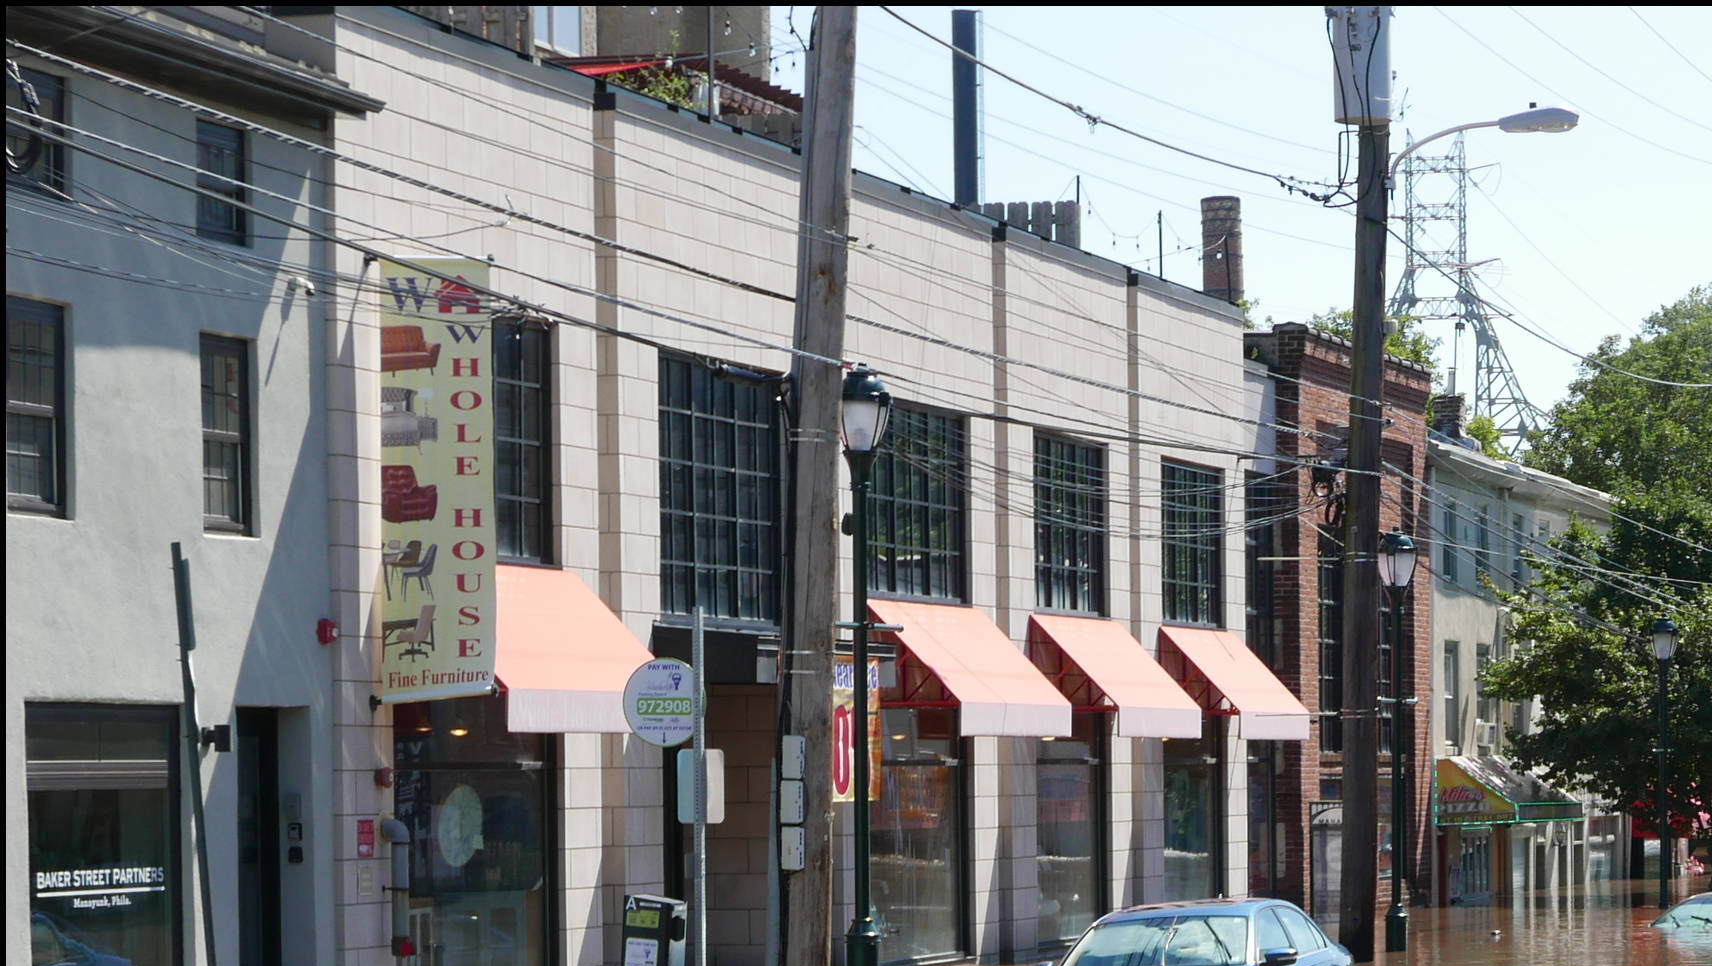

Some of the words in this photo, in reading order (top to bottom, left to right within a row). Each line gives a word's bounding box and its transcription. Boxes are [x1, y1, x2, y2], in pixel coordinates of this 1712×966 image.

[445, 325, 485, 477] WHOLE
[451, 508, 485, 658] HOUSE
[388, 671, 418, 689] Fine
[421, 667, 489, 686] Furniture
[638, 700, 691, 713] 972908
[36, 871, 71, 889] BAKER
[72, 869, 111, 887] STREET
[112, 867, 164, 885] PARTNERS
[73, 896, 111, 909] Manayunk,
[111, 895, 132, 906] Phila.
